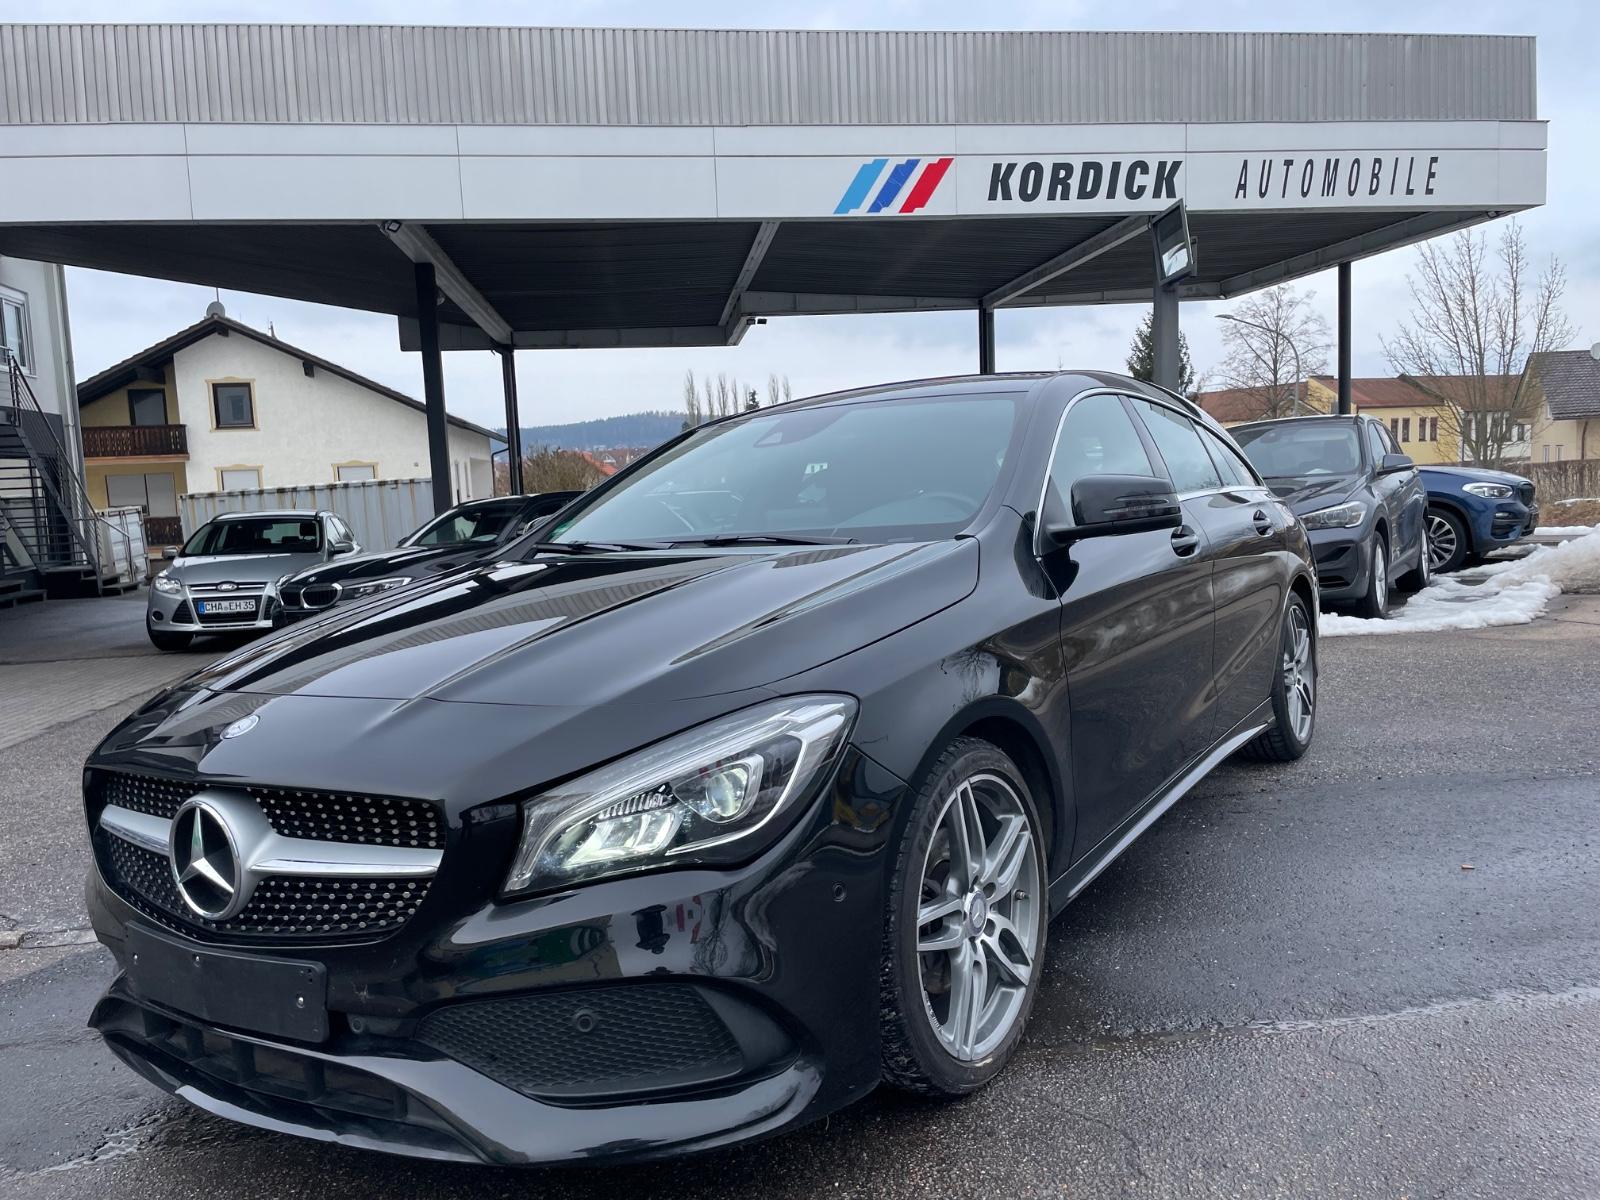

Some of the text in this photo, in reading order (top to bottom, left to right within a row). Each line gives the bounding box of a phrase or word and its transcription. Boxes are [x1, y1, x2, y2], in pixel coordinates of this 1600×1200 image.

[987, 156, 1439, 202] KORDICK AUTOMOBILE
[205, 602, 223, 611] CHA
[243, 600, 255, 610] 35
